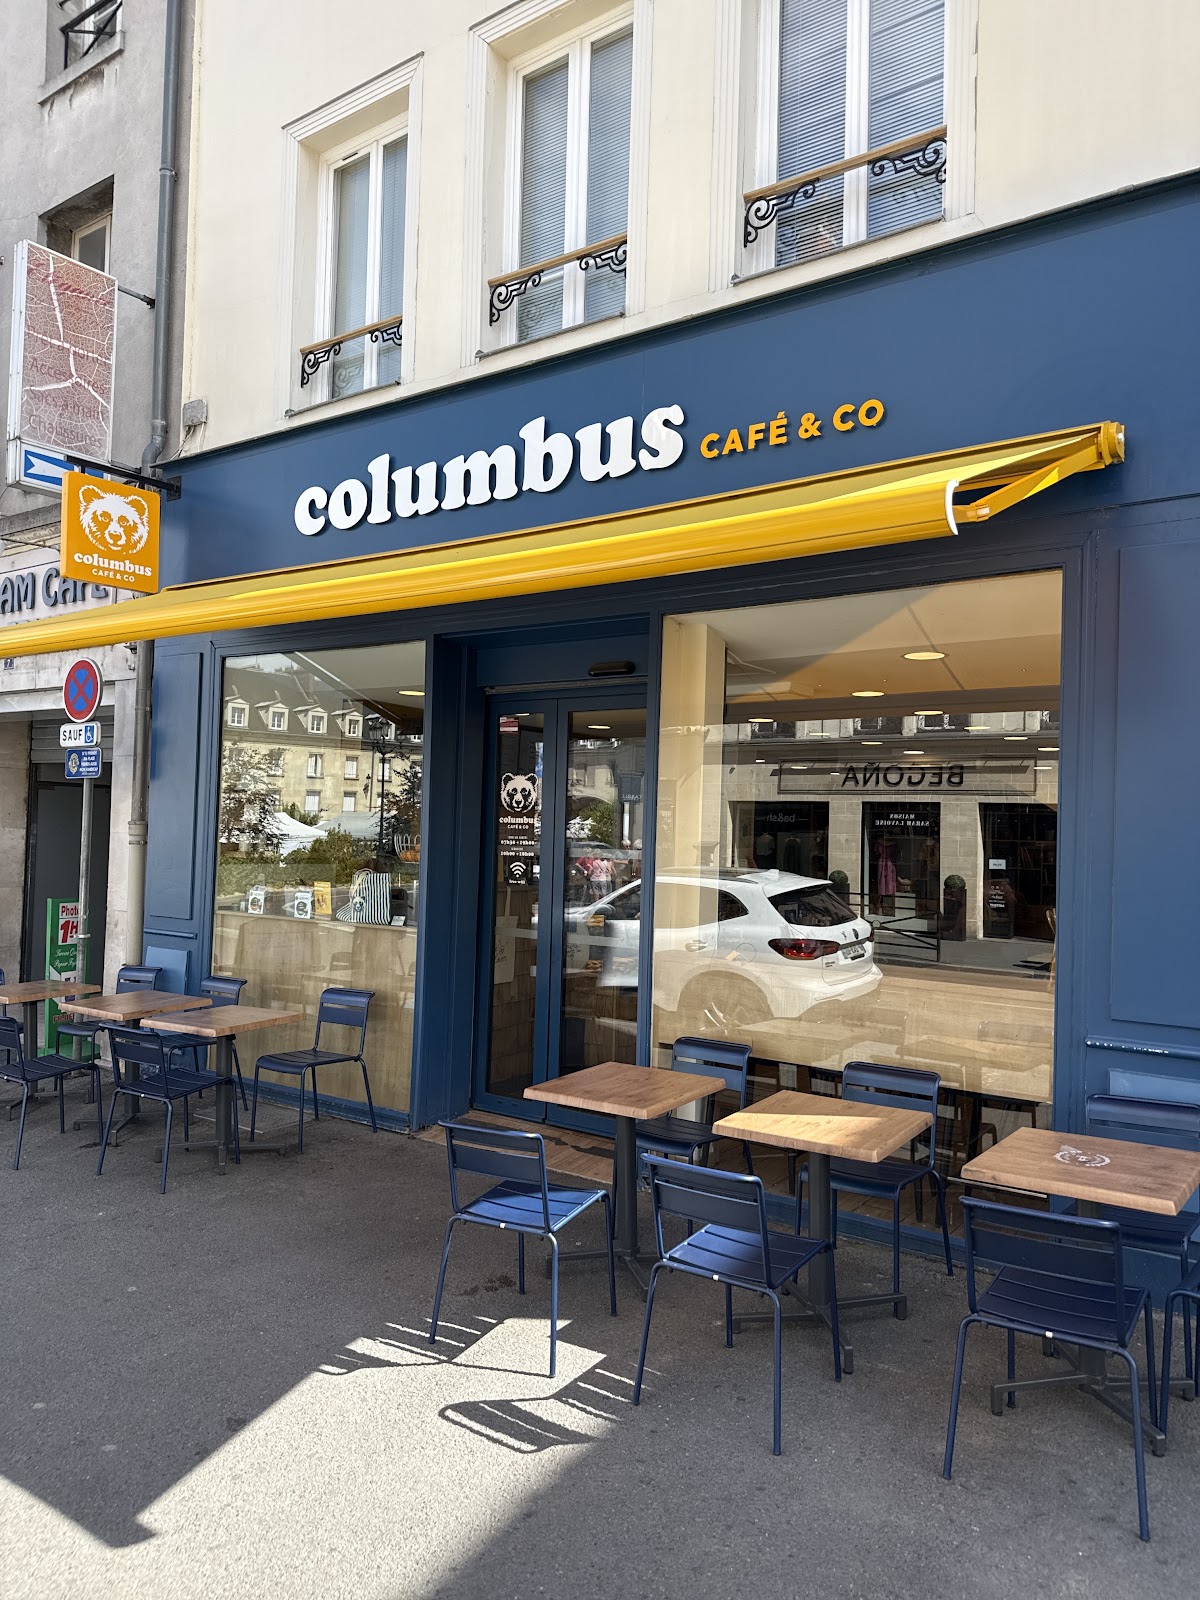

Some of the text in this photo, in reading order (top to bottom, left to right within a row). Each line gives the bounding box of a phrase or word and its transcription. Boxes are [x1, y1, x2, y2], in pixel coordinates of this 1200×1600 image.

[28, 414, 102, 447] Chaussures
[293, 399, 885, 536] columbus CAFÉ & CO
[73, 552, 152, 577] columbus
[92, 568, 114, 579] CAFÉ
[123, 574, 135, 583] CO
[62, 728, 83, 742] SAUF
[61, 905, 79, 917] Phot
